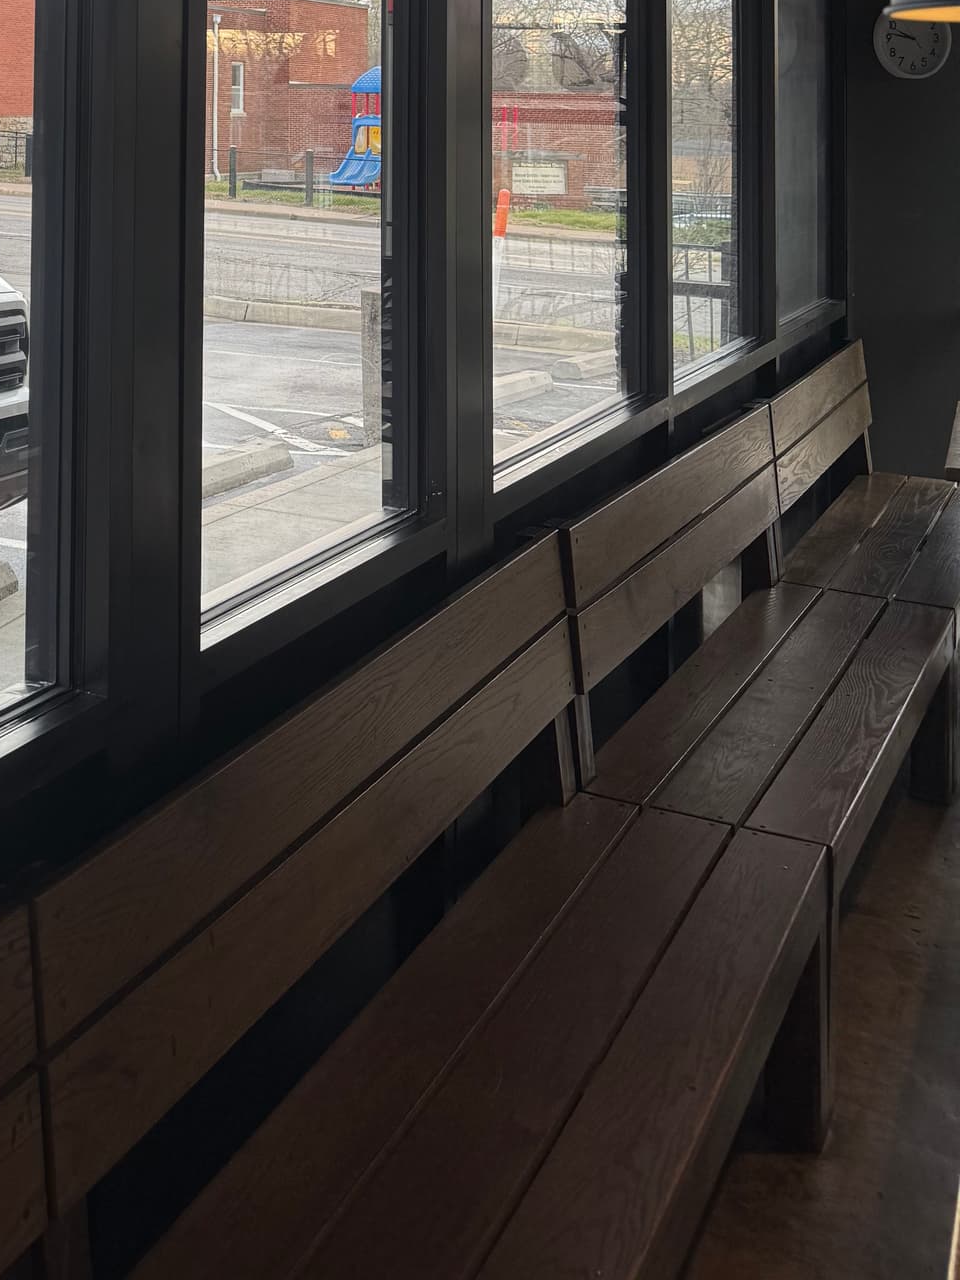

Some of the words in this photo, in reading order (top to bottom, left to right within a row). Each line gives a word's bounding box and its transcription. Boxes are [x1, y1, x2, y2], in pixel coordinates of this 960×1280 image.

[890, 47, 896, 57] 8
[930, 48, 936, 56] 4
[898, 56, 905, 66] 7
[910, 61, 916, 70] 6
[921, 57, 928, 67] 5
